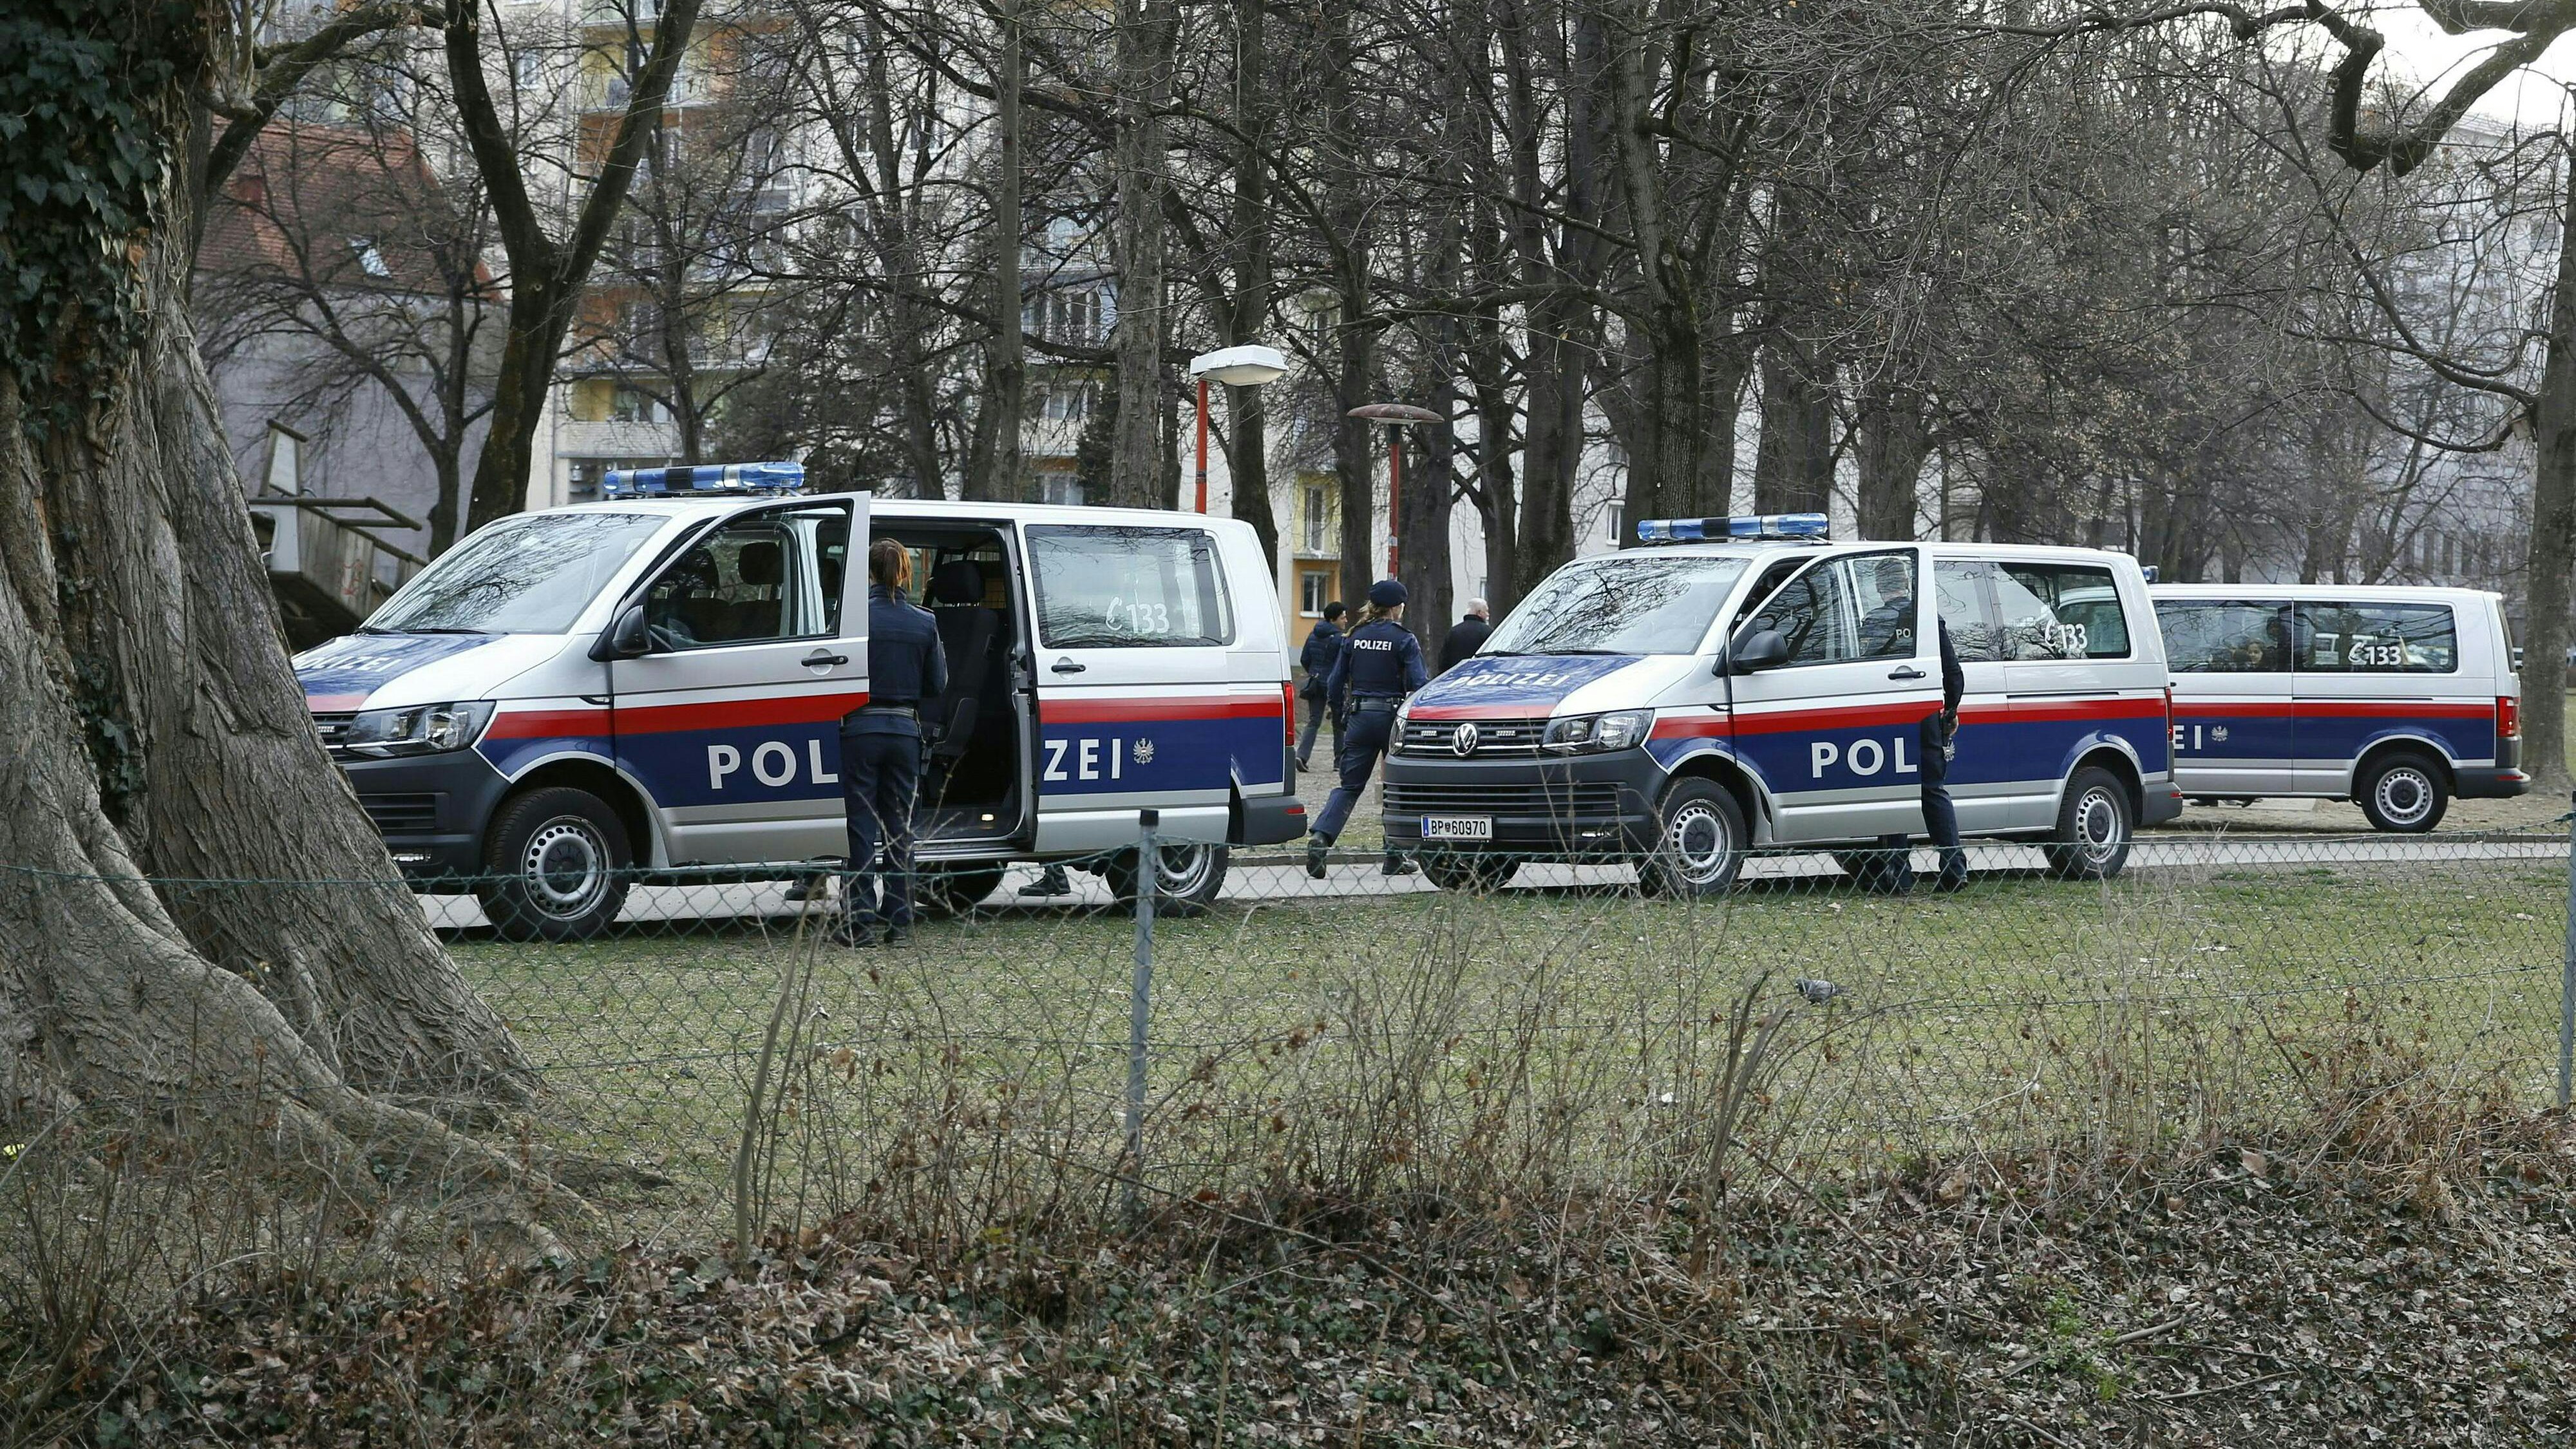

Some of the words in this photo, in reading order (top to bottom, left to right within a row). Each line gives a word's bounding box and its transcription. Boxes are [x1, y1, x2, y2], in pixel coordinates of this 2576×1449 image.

[1125, 603, 1170, 634] 133
[1353, 639, 1392, 651] POLIZEI
[2057, 623, 2088, 650] 133
[2363, 645, 2401, 666] 133
[1447, 673, 1571, 688] POLIZEI
[1431, 820, 1443, 835] BP
[1452, 820, 1486, 835] 60970
